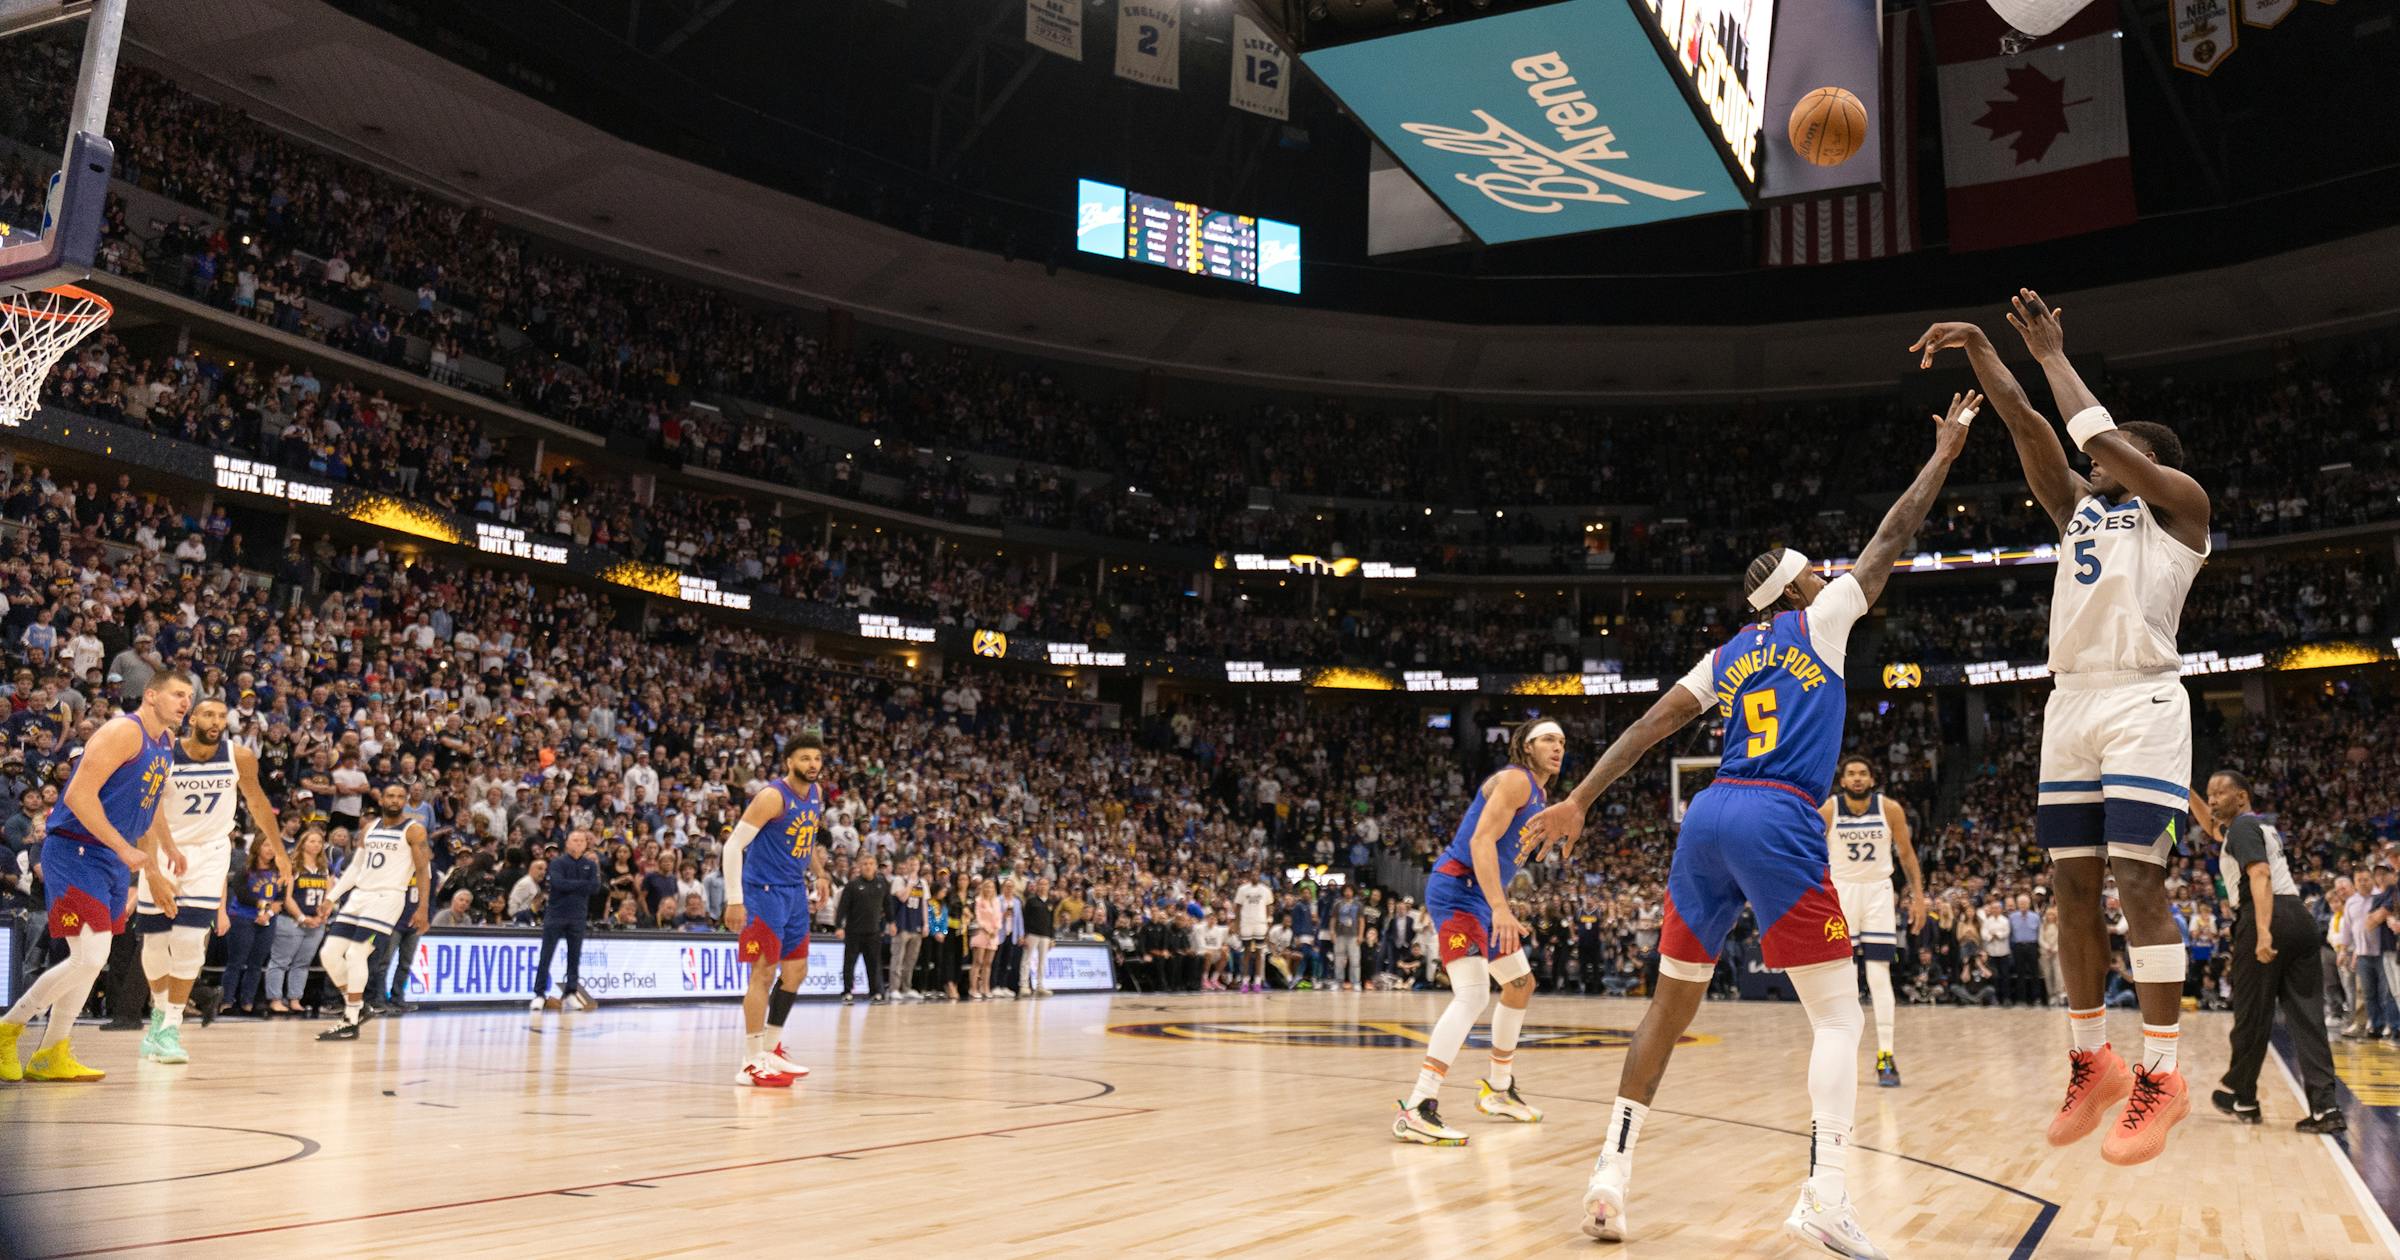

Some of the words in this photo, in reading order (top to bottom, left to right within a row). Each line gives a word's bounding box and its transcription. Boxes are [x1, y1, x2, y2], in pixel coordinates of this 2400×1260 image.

[2186, 1, 2218, 18] NBA
[1138, 25, 1158, 57] 2
[1246, 54, 1279, 89] 12
[1510, 50, 1630, 161] Arena
[1697, 22, 1757, 183] SCORE
[1400, 109, 1707, 213] Ball
[217, 470, 260, 493] UNTIL
[263, 478, 286, 498] WE
[288, 482, 333, 505] SCORE
[2074, 538, 2102, 585] 5
[1742, 688, 1779, 759] 5
[174, 778, 232, 790] WOLVES
[183, 792, 222, 815] 27
[796, 826, 814, 847] 27
[1839, 830, 1883, 840] WOLVES
[366, 851, 386, 869] 10
[1846, 842, 1876, 861] 32
[305, 888, 324, 906] 27
[623, 972, 657, 988] Pixel
